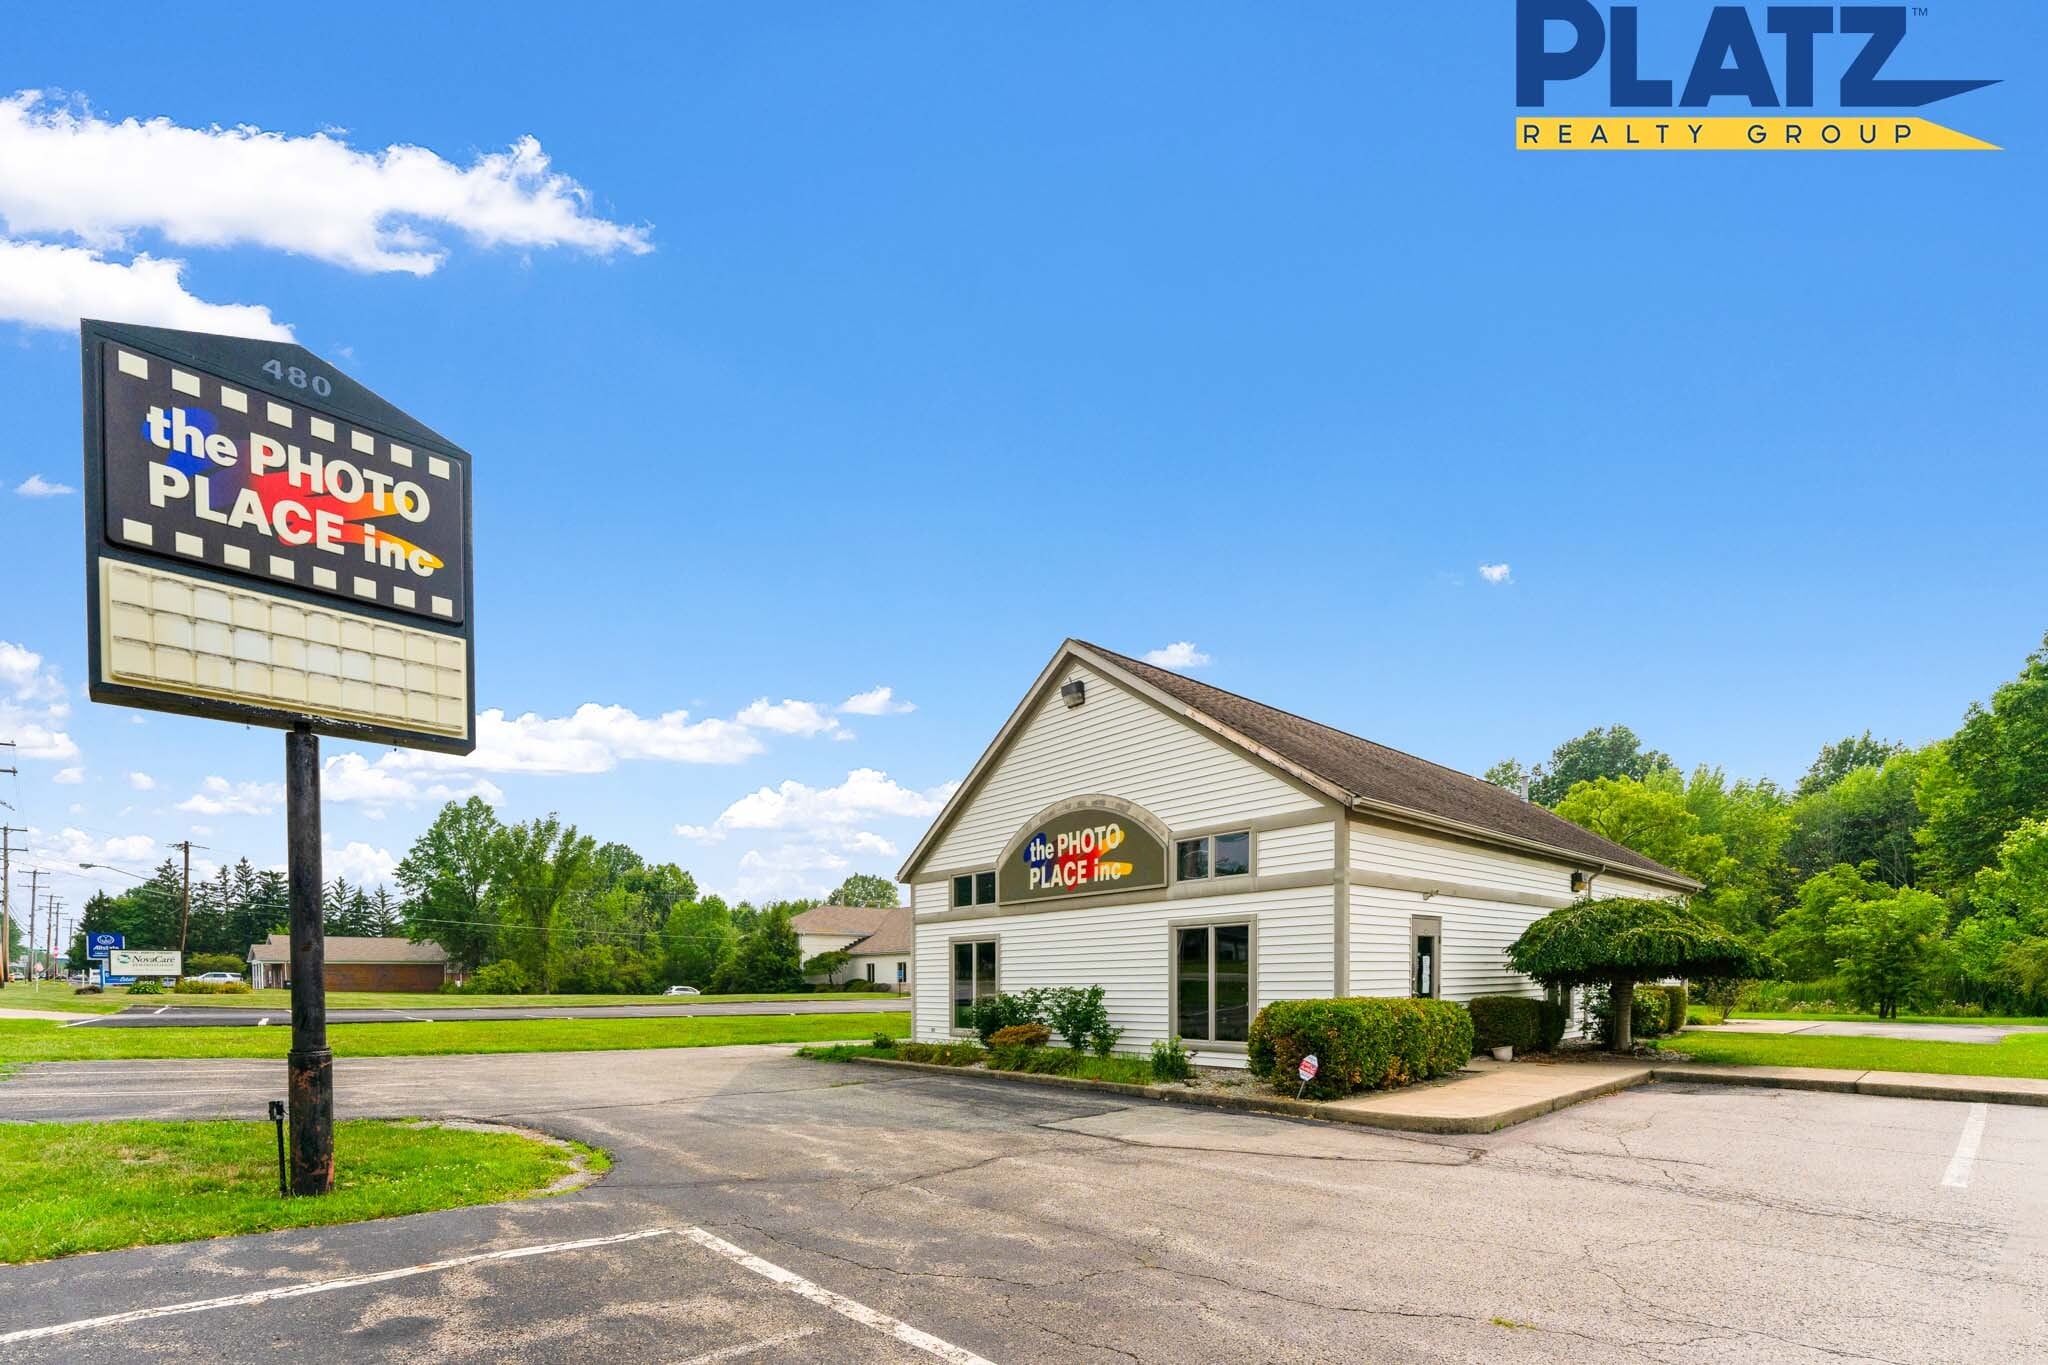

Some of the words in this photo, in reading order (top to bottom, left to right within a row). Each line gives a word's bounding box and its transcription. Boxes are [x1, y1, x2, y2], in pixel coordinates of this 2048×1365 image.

[262, 359, 332, 397] 480
[145, 406, 238, 466] the
[250, 433, 431, 523] PHOTO
[149, 461, 345, 555] PLACE
[363, 523, 435, 577] inc
[1029, 838, 1055, 862] the
[1057, 823, 1121, 857] PHOTO
[1029, 860, 1088, 890] PLACE
[1093, 858, 1122, 882] inc
[133, 955, 176, 963] NovaCare
